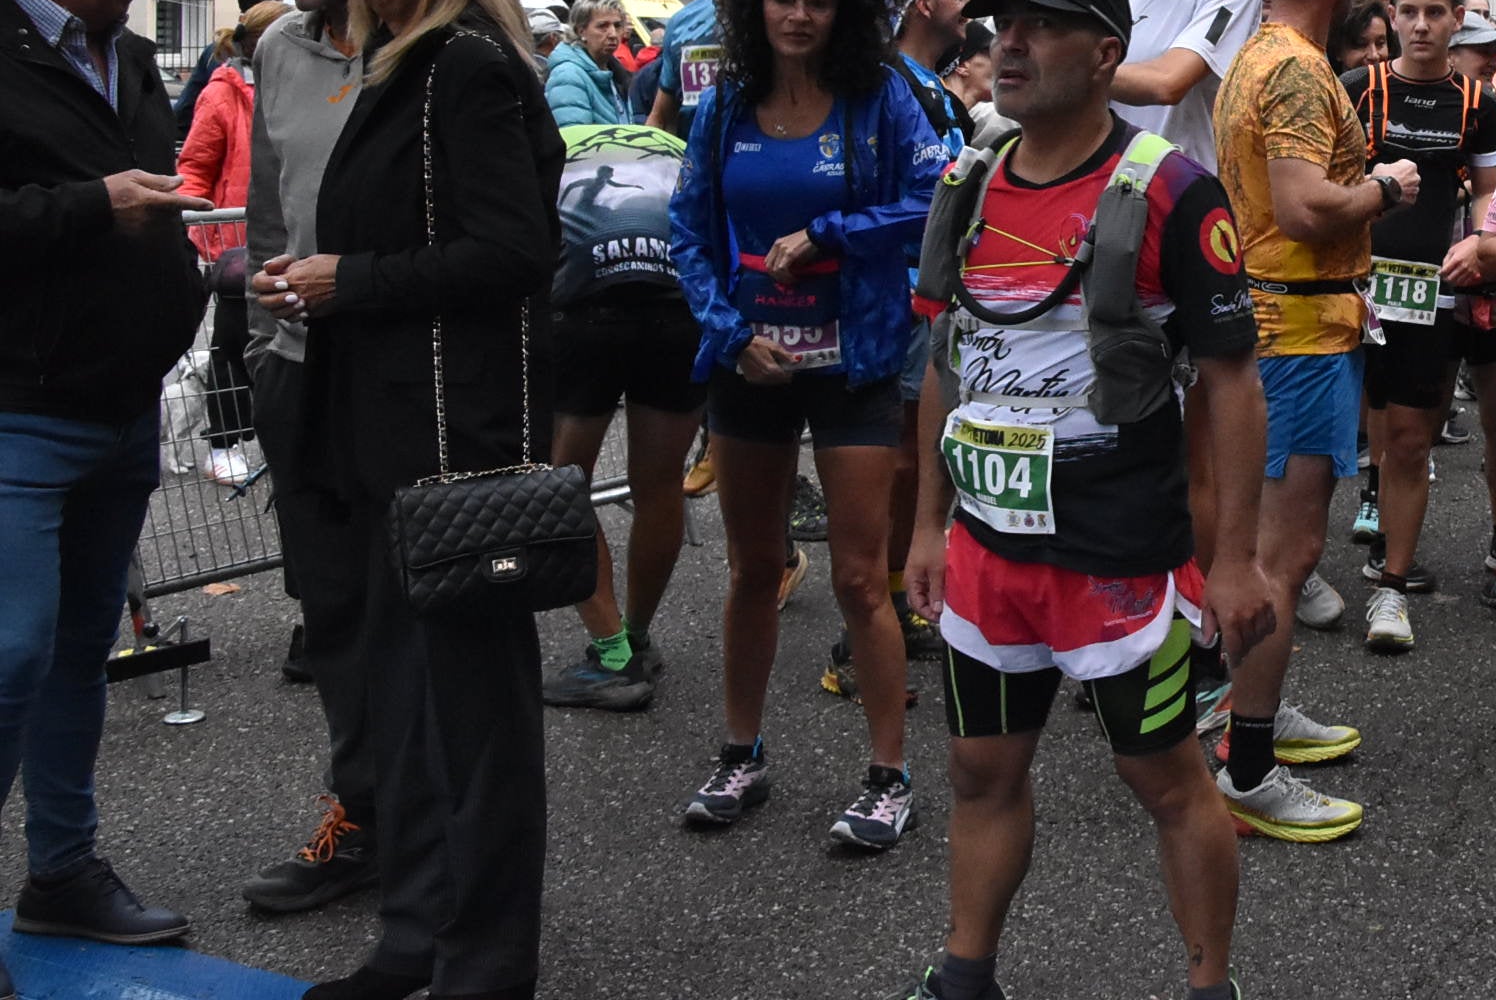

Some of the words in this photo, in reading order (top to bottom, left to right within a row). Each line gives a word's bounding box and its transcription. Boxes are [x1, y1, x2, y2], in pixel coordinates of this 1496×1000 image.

[1404, 95, 1437, 106] land
[1008, 433, 1047, 450] 2025
[952, 444, 1032, 498] 1104
